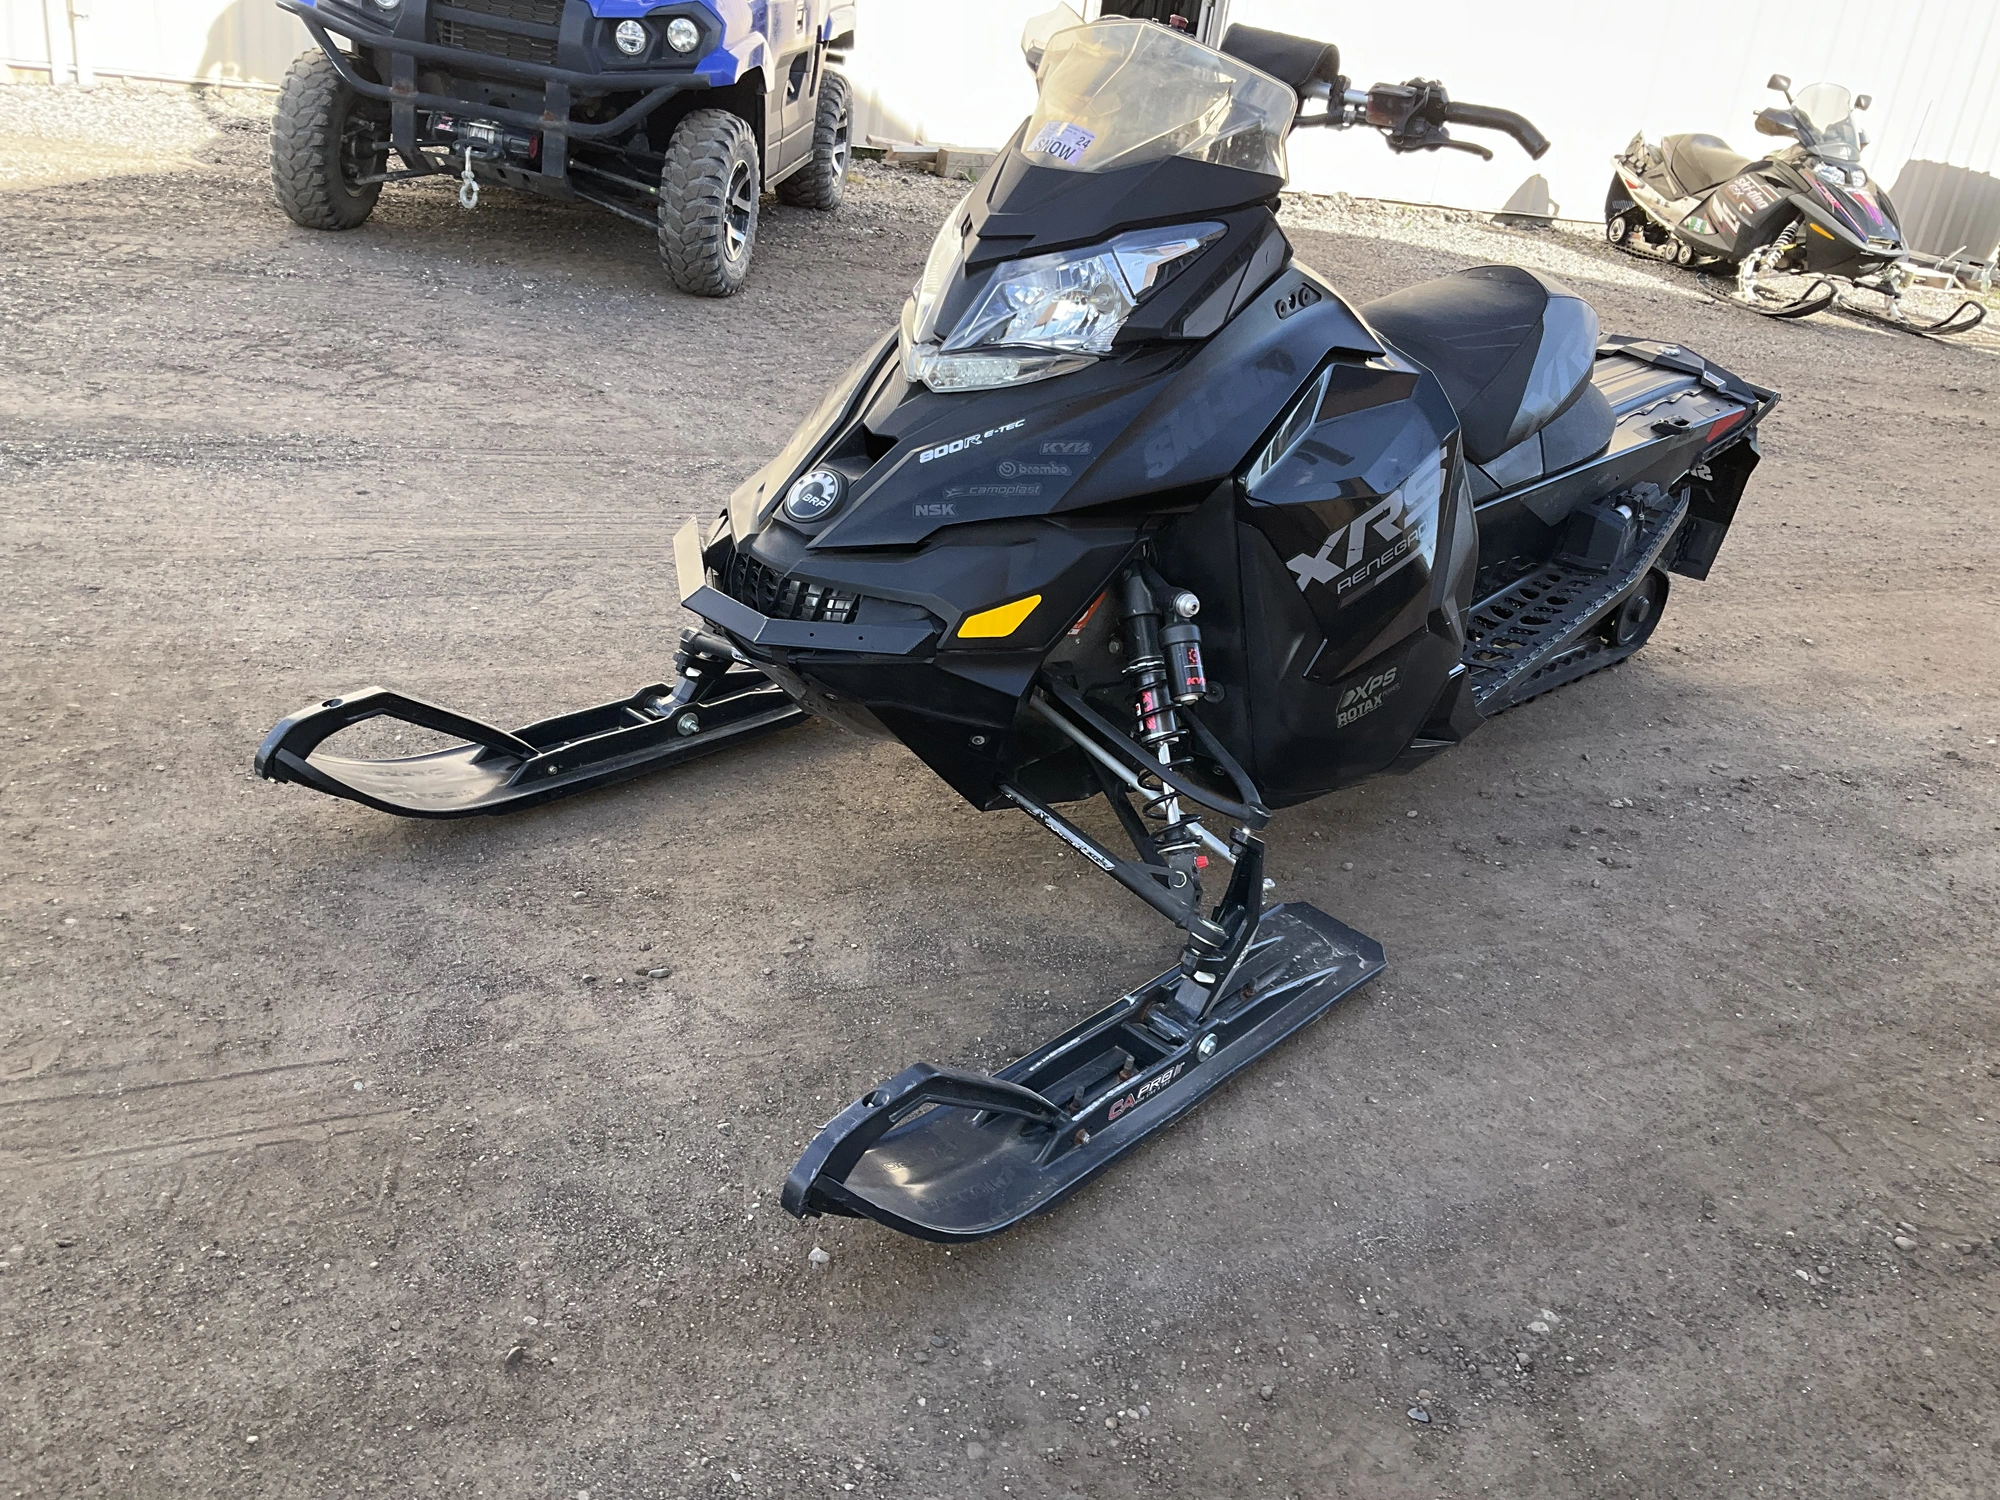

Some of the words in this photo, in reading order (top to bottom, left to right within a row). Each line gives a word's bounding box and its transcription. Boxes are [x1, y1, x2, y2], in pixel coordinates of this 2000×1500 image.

[1035, 138, 1077, 161] SNOW
[1075, 136, 1091, 149] 24
[919, 434, 983, 464] 800R
[1041, 441, 1091, 454] KYB
[1019, 463, 1068, 476] brembo
[968, 483, 1040, 498] camoplast
[802, 493, 827, 508] BRP
[915, 504, 957, 517] NSK
[1336, 520, 1429, 595] RENEGAD
[1352, 667, 1398, 704] XPS
[1337, 693, 1383, 728] ROTAX
